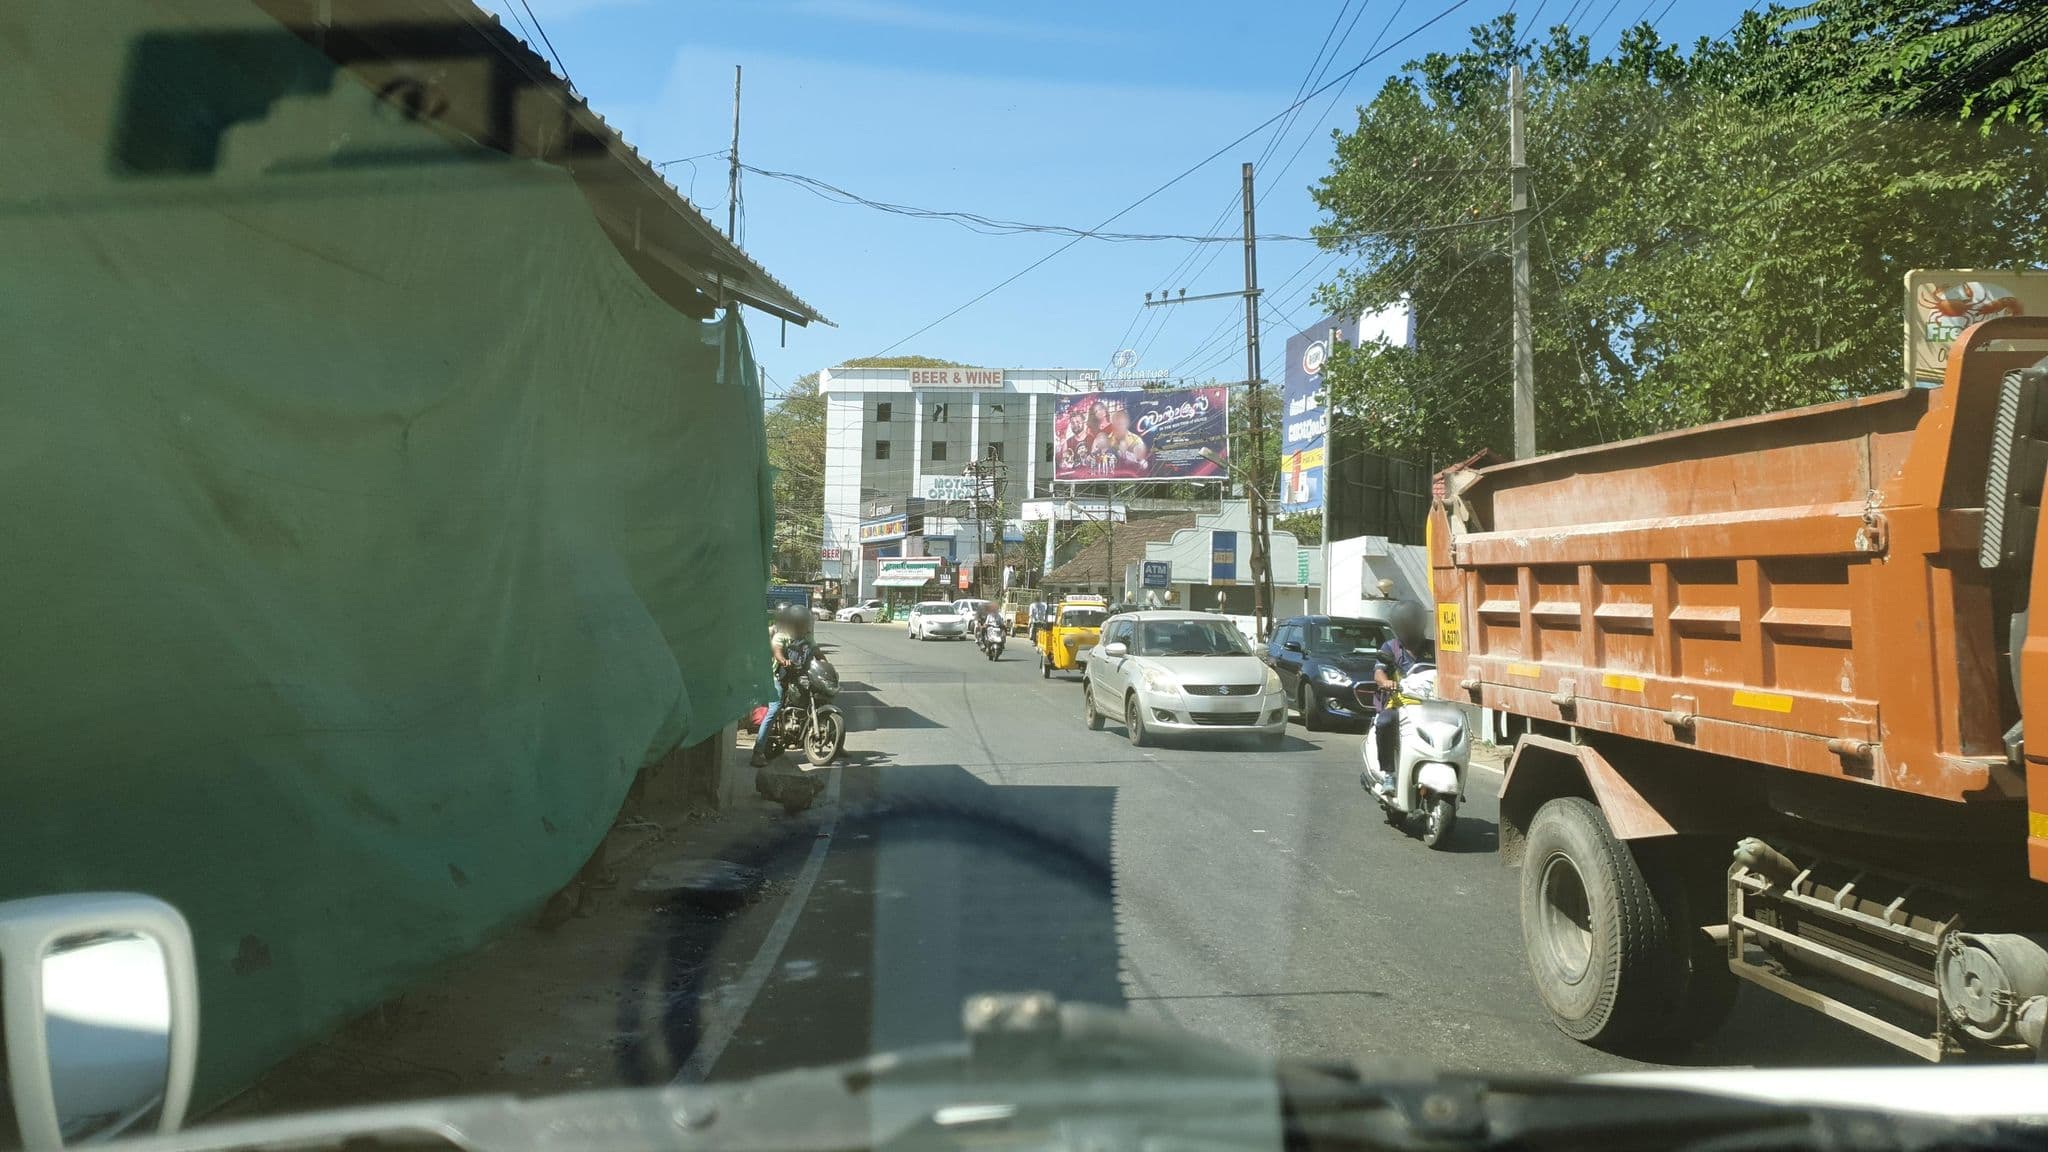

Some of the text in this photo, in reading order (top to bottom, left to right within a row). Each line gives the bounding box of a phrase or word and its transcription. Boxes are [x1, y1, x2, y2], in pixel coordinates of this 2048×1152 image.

[1927, 321, 1961, 341] Fre
[912, 371, 1001, 384] BEER & WINE
[934, 478, 983, 489] MOTHE
[822, 549, 840, 558] BEER
[1145, 564, 1167, 574] ATM
